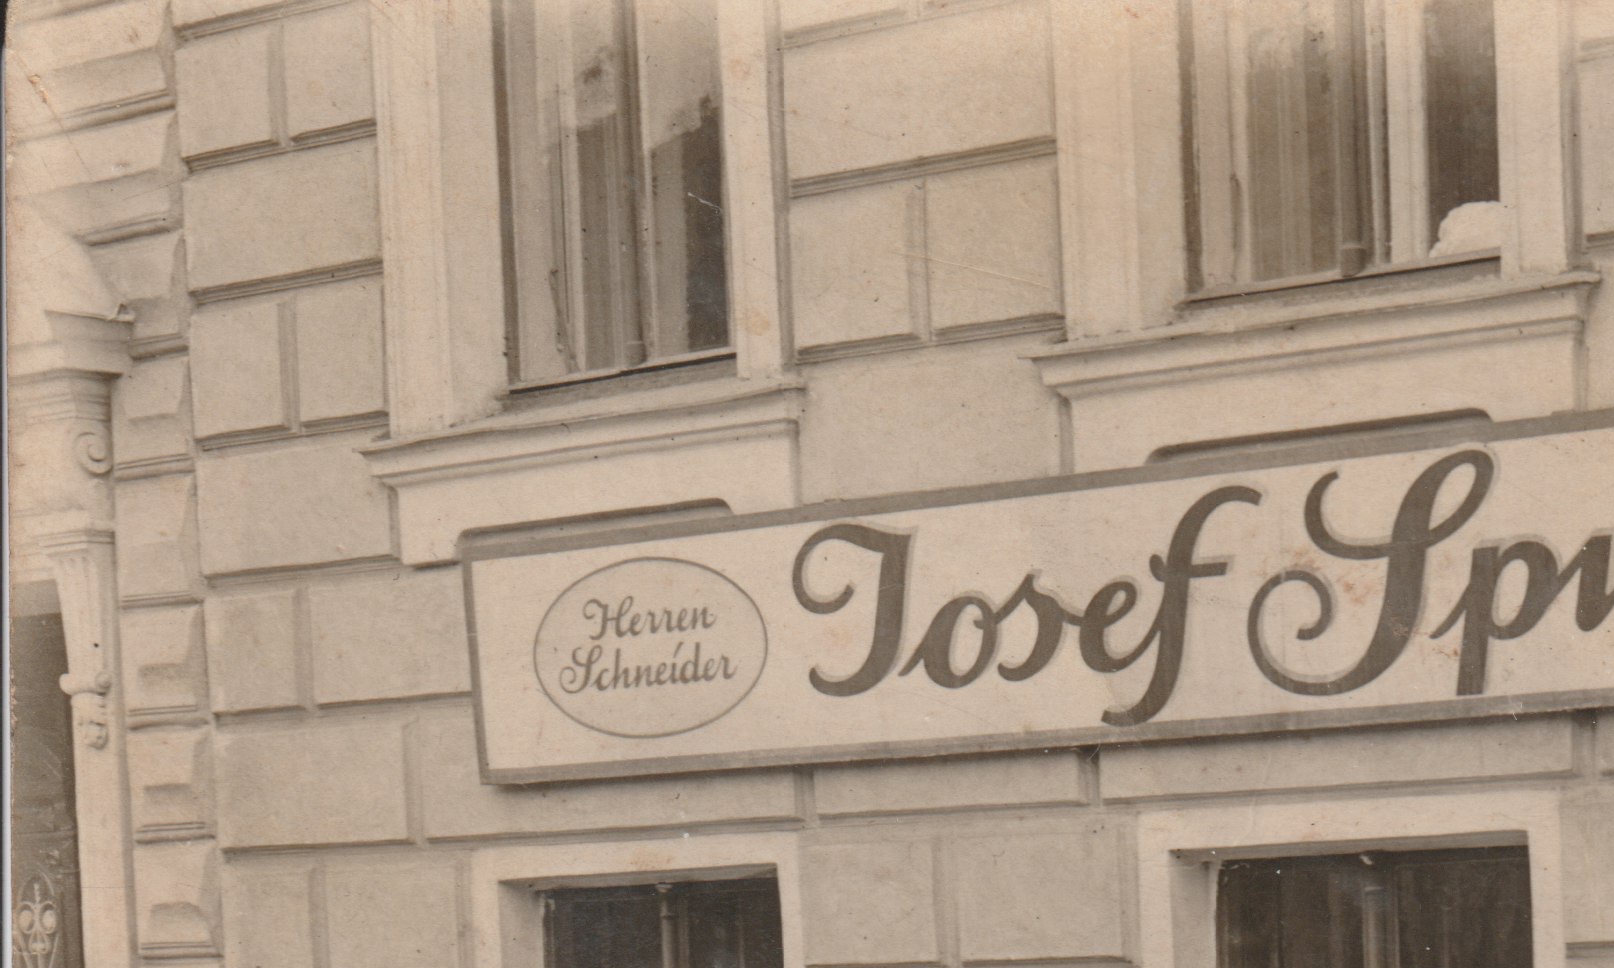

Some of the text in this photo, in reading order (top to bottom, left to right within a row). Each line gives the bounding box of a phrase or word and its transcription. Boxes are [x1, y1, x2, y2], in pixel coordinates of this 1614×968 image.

[582, 595, 717, 641] Herren
[792, 484, 1263, 728] Josef
[559, 641, 738, 695] Schneider
